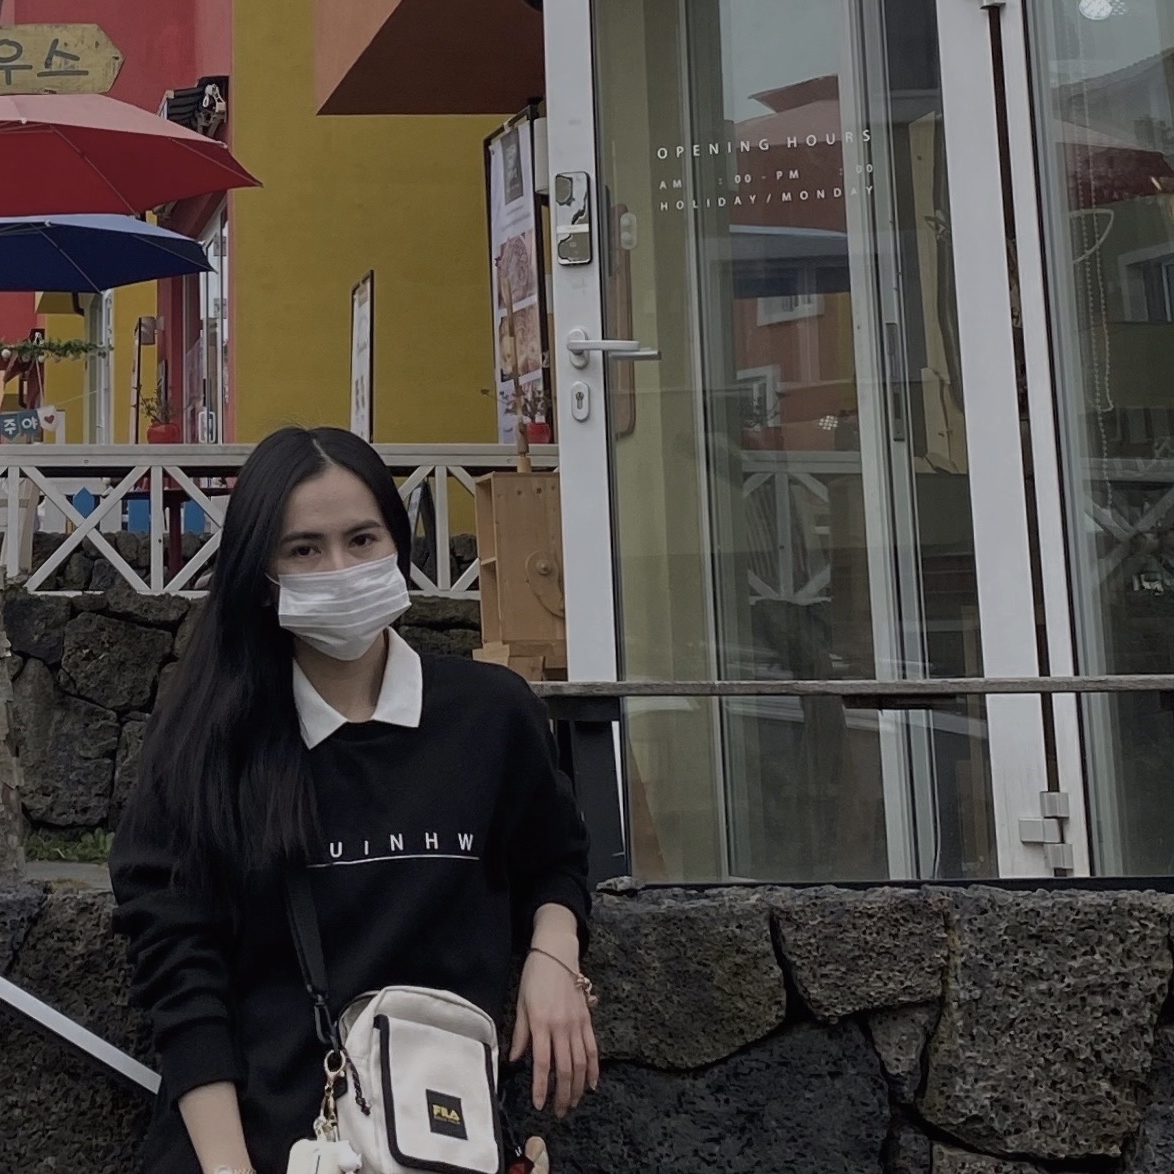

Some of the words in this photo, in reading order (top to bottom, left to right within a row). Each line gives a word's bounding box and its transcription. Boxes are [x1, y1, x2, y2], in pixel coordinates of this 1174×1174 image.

[657, 138, 770, 160] OPENING
[787, 129, 871, 149] HOURS
[659, 178, 683, 190] AM
[776, 169, 800, 181] PM
[432, 1103, 460, 1121] FILA
